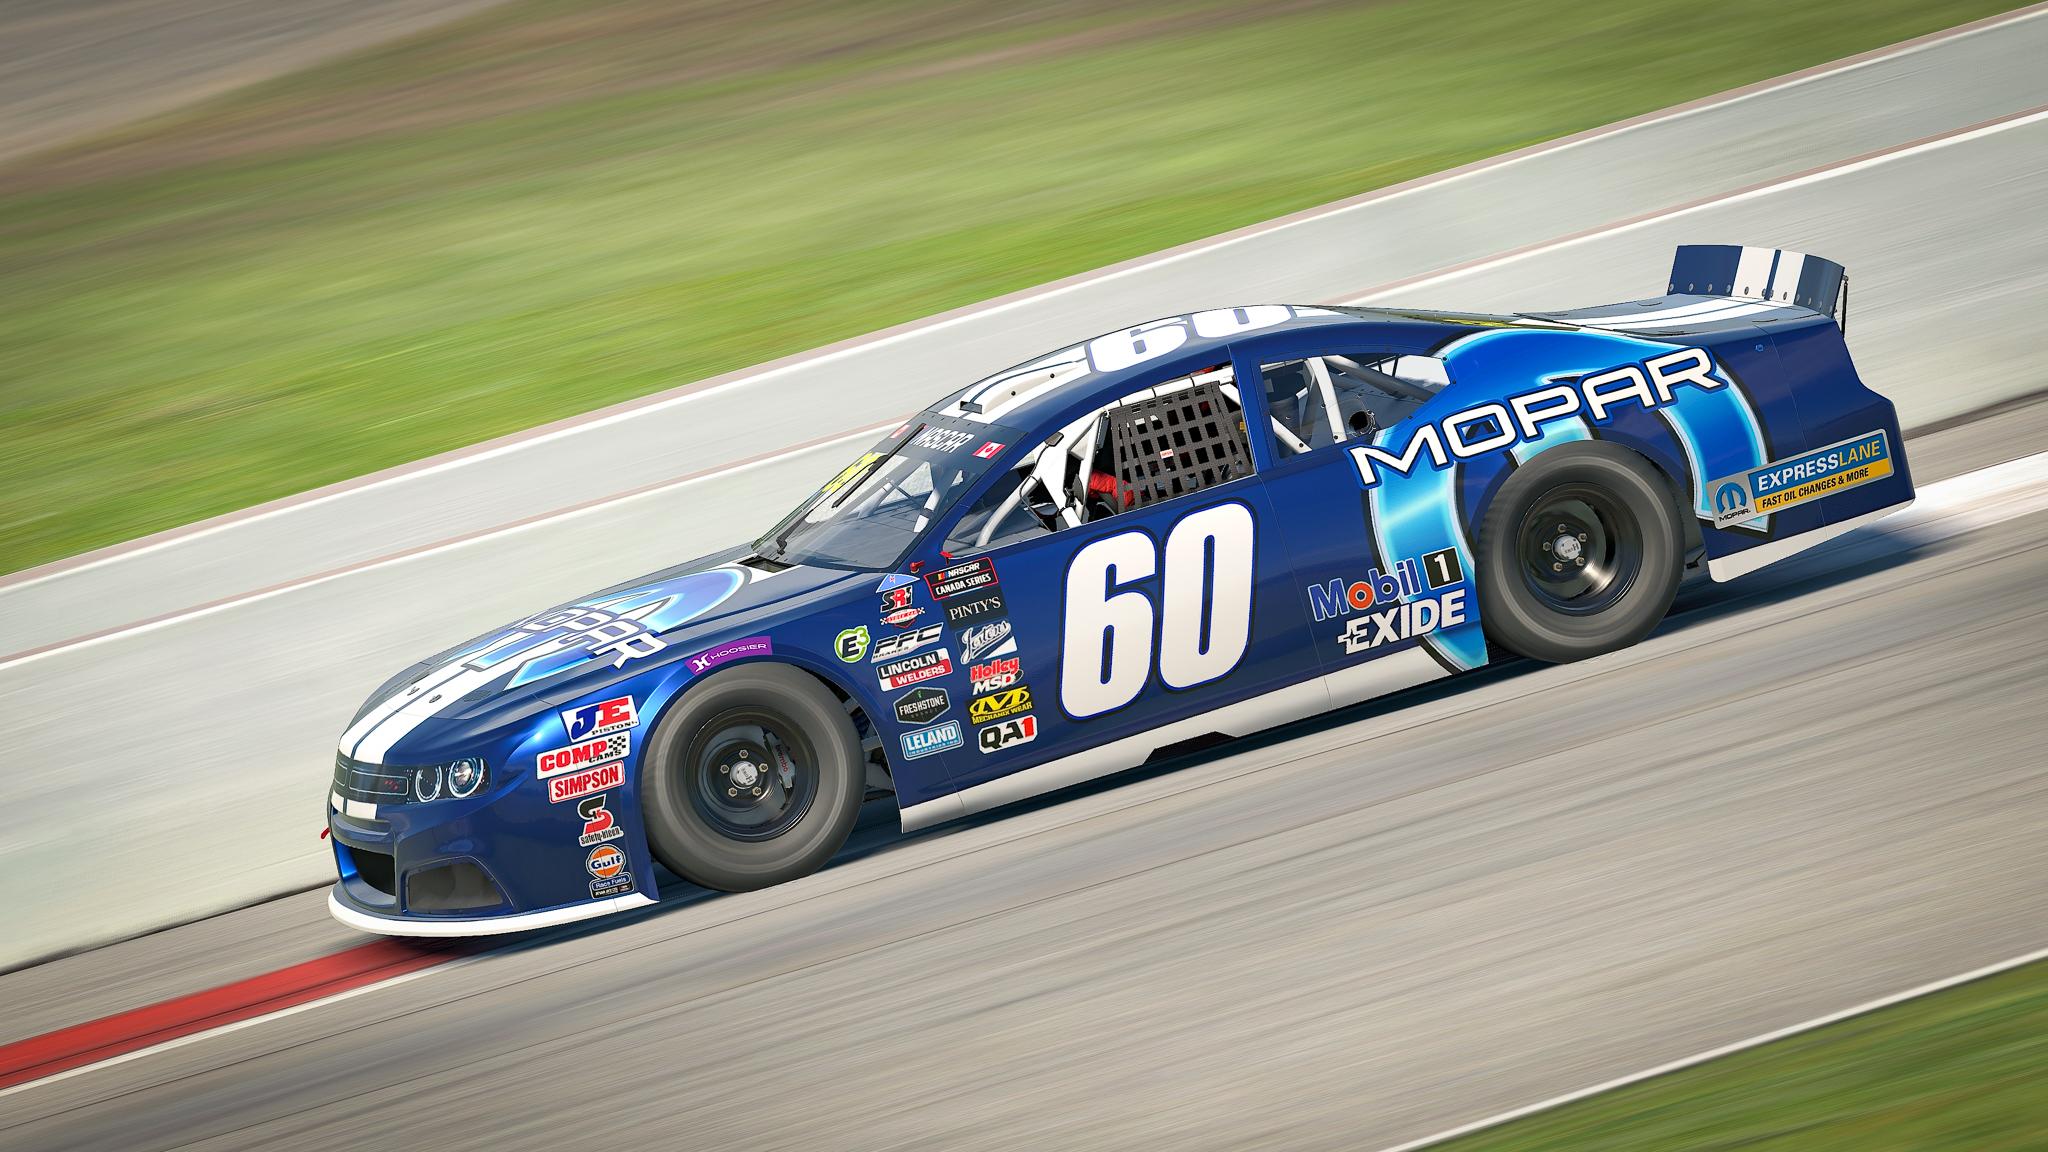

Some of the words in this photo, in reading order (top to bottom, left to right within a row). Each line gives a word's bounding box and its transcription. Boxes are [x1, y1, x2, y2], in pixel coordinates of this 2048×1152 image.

[1349, 347, 1722, 485] MOPAR
[1762, 493, 1782, 508] FAST
[1784, 489, 1797, 502] OIL
[1798, 479, 1837, 497] CHANGES
[1837, 475, 1845, 485] &
[1846, 467, 1870, 482] MORE
[1718, 508, 1750, 522] MOPAR
[948, 562, 981, 578] NASCAR
[935, 581, 967, 595] CANADA
[966, 572, 992, 587] SERIES
[1308, 557, 1423, 622] Mobil
[949, 596, 1002, 620] PINTY'S
[1060, 502, 1256, 719] 60
[1337, 588, 1466, 655] EXIDE
[874, 622, 943, 654] PFC
[710, 643, 768, 660] HOOSIER
[881, 652, 938, 678] LINCOLN
[896, 665, 946, 685] WELDERS
[970, 657, 1020, 683] Holley
[972, 674, 1017, 695] MSD
[571, 697, 631, 740] JE
[898, 695, 945, 716] FRESHSTONE
[971, 710, 1010, 725] MECHANIX
[1010, 701, 1033, 715] WEAR
[905, 725, 957, 752] LELAND
[980, 716, 1035, 749] QA1
[540, 740, 608, 772] COMP
[588, 749, 622, 763] CAMS
[555, 765, 619, 798] SIMPSON
[591, 855, 622, 869] Gulf
